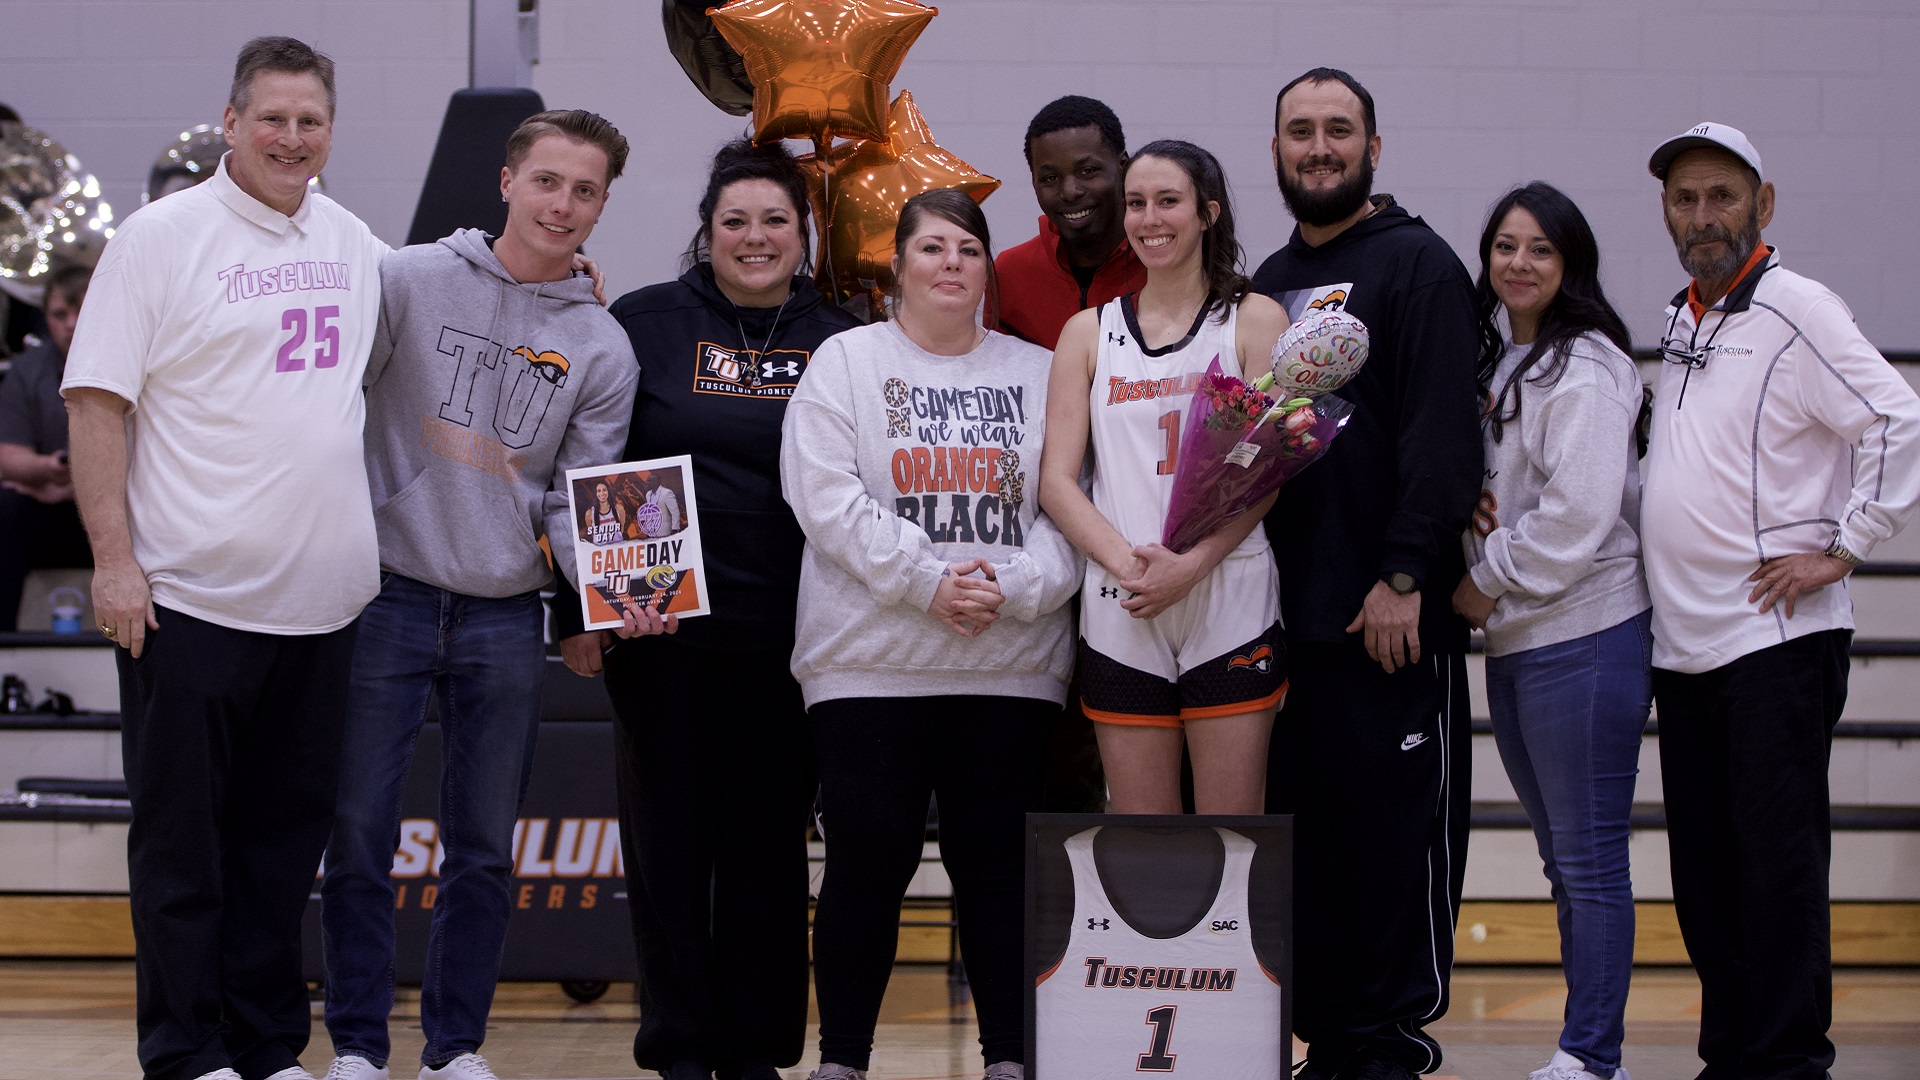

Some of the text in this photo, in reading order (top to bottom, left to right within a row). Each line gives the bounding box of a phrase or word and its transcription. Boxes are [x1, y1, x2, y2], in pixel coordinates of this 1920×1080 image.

[219, 262, 350, 303] TUSCULUM
[275, 305, 340, 373] 25
[705, 346, 748, 382] TU
[437, 326, 568, 449] TU
[918, 421, 1025, 449] we wear
[1157, 410, 1181, 475] 1
[891, 446, 1001, 495] ORANGE
[587, 523, 621, 535] SENIOR
[597, 532, 615, 542] DAY
[895, 494, 1023, 547] BLACK
[591, 539, 683, 574] GAMEDAY
[605, 570, 631, 596] TU
[1405, 732, 1423, 744] NIKE
[1211, 919, 1239, 931] SAC
[1084, 956, 1237, 991] TUSCULUM
[1136, 1004, 1178, 1073] 1
